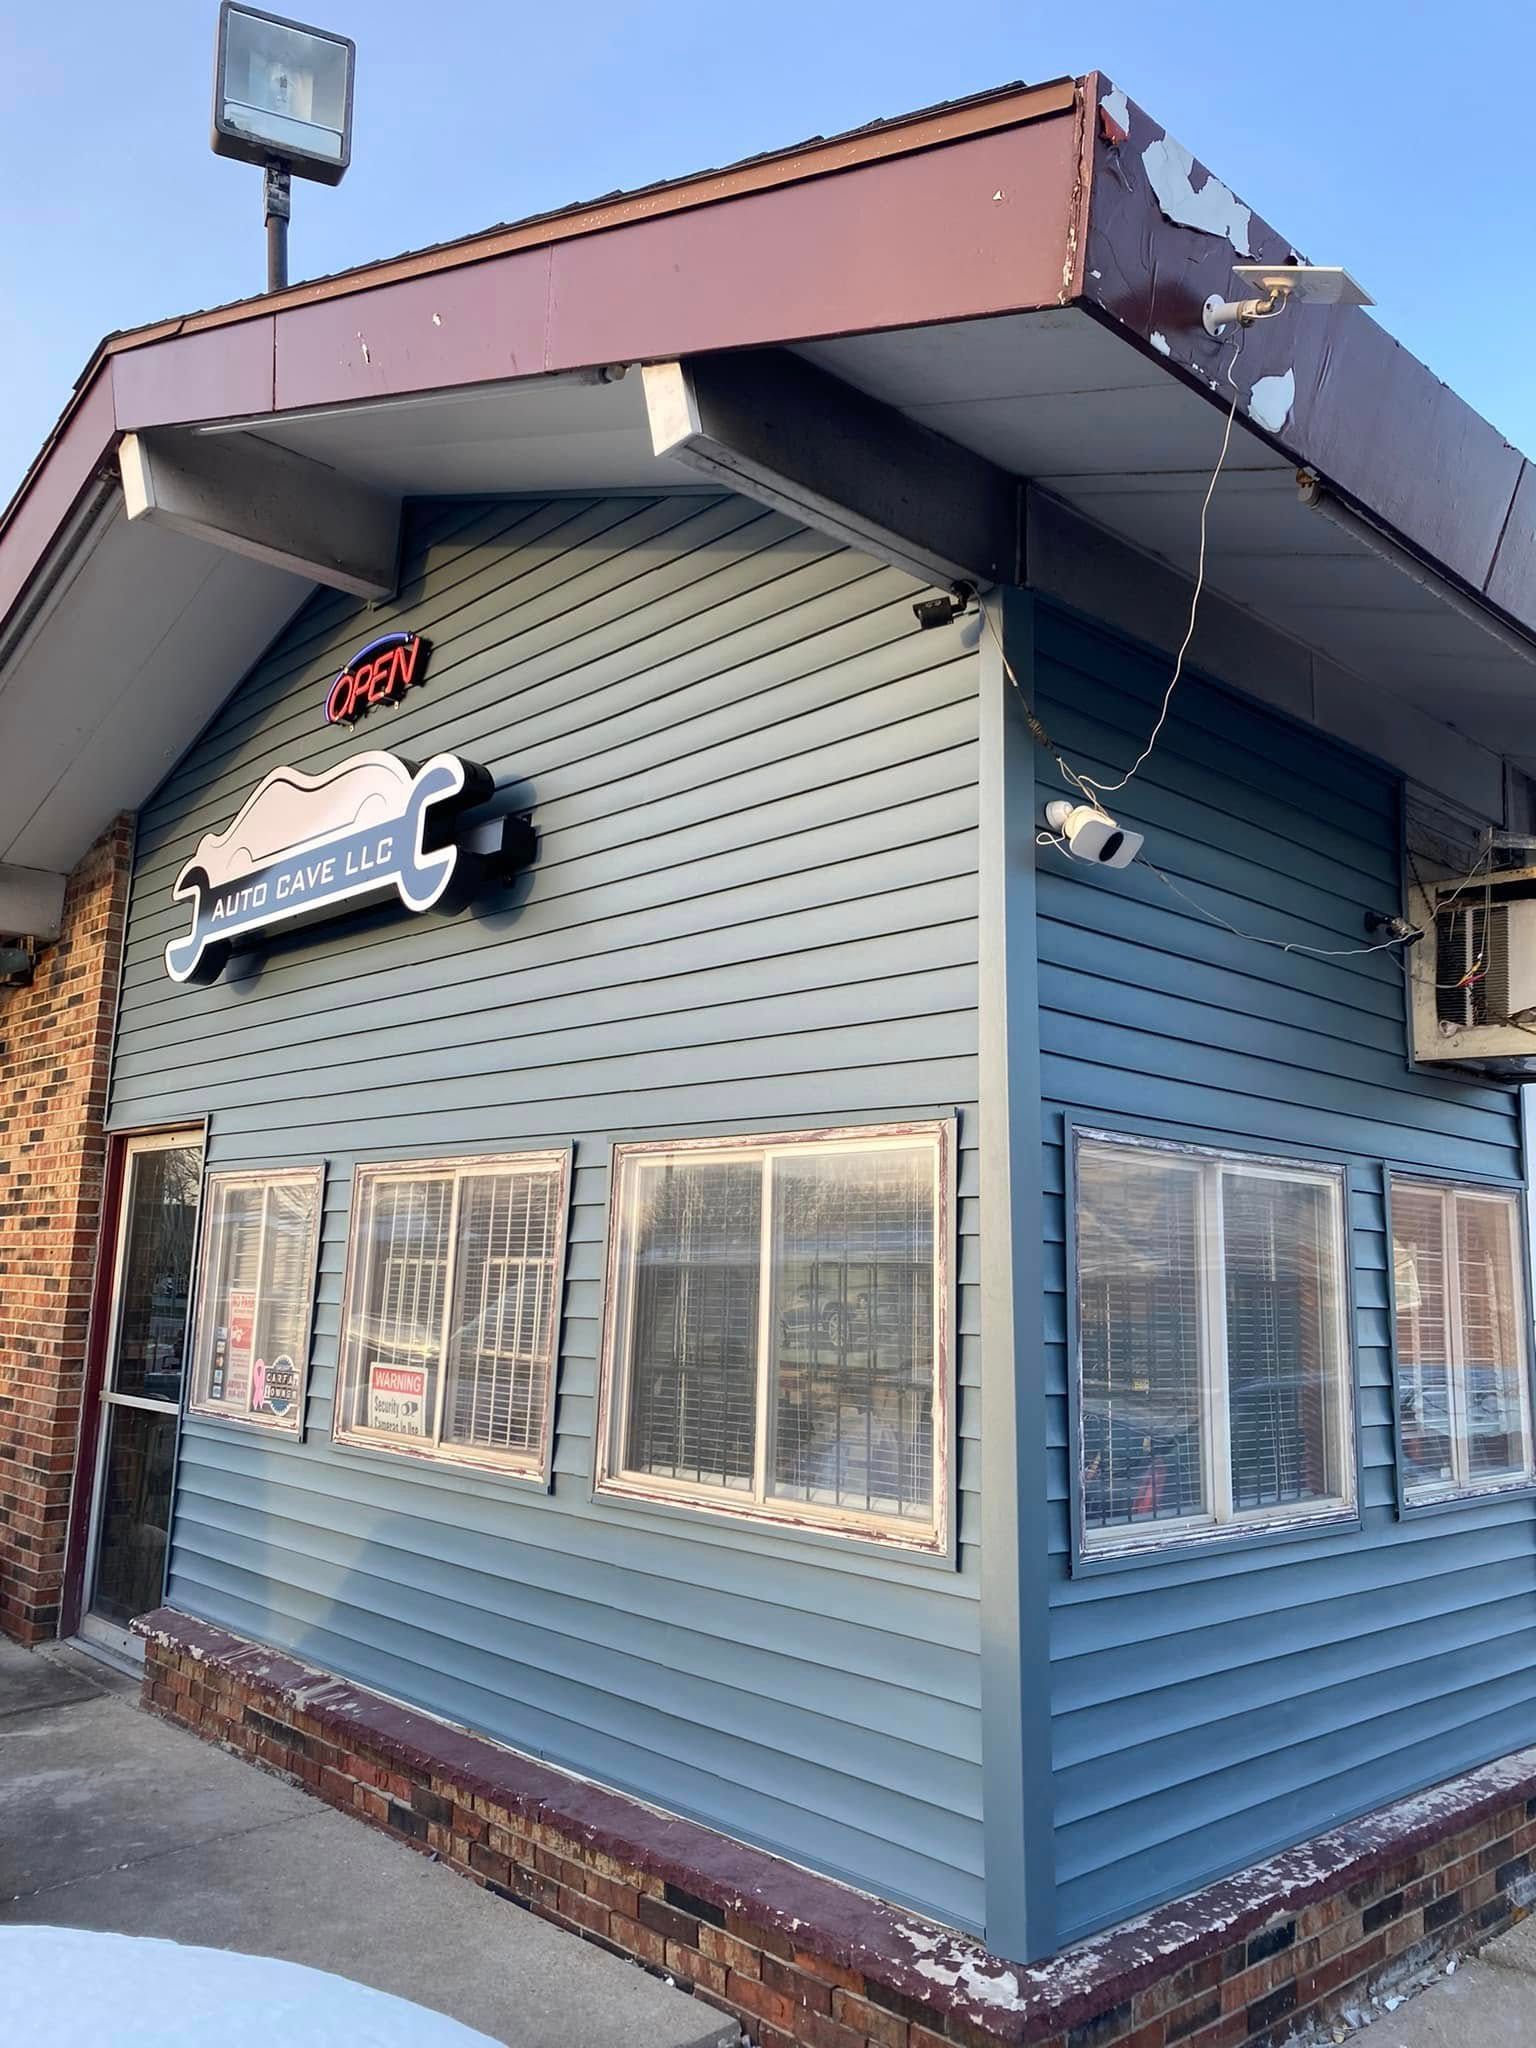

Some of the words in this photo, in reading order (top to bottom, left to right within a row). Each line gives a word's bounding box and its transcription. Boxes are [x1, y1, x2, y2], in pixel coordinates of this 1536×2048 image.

[329, 635, 420, 722] OPEN
[211, 882, 268, 922] AUTO
[276, 857, 336, 899] CAVE
[345, 836, 393, 875] LLC
[375, 1395, 399, 1418] Security
[376, 1370, 422, 1393] WARNING
